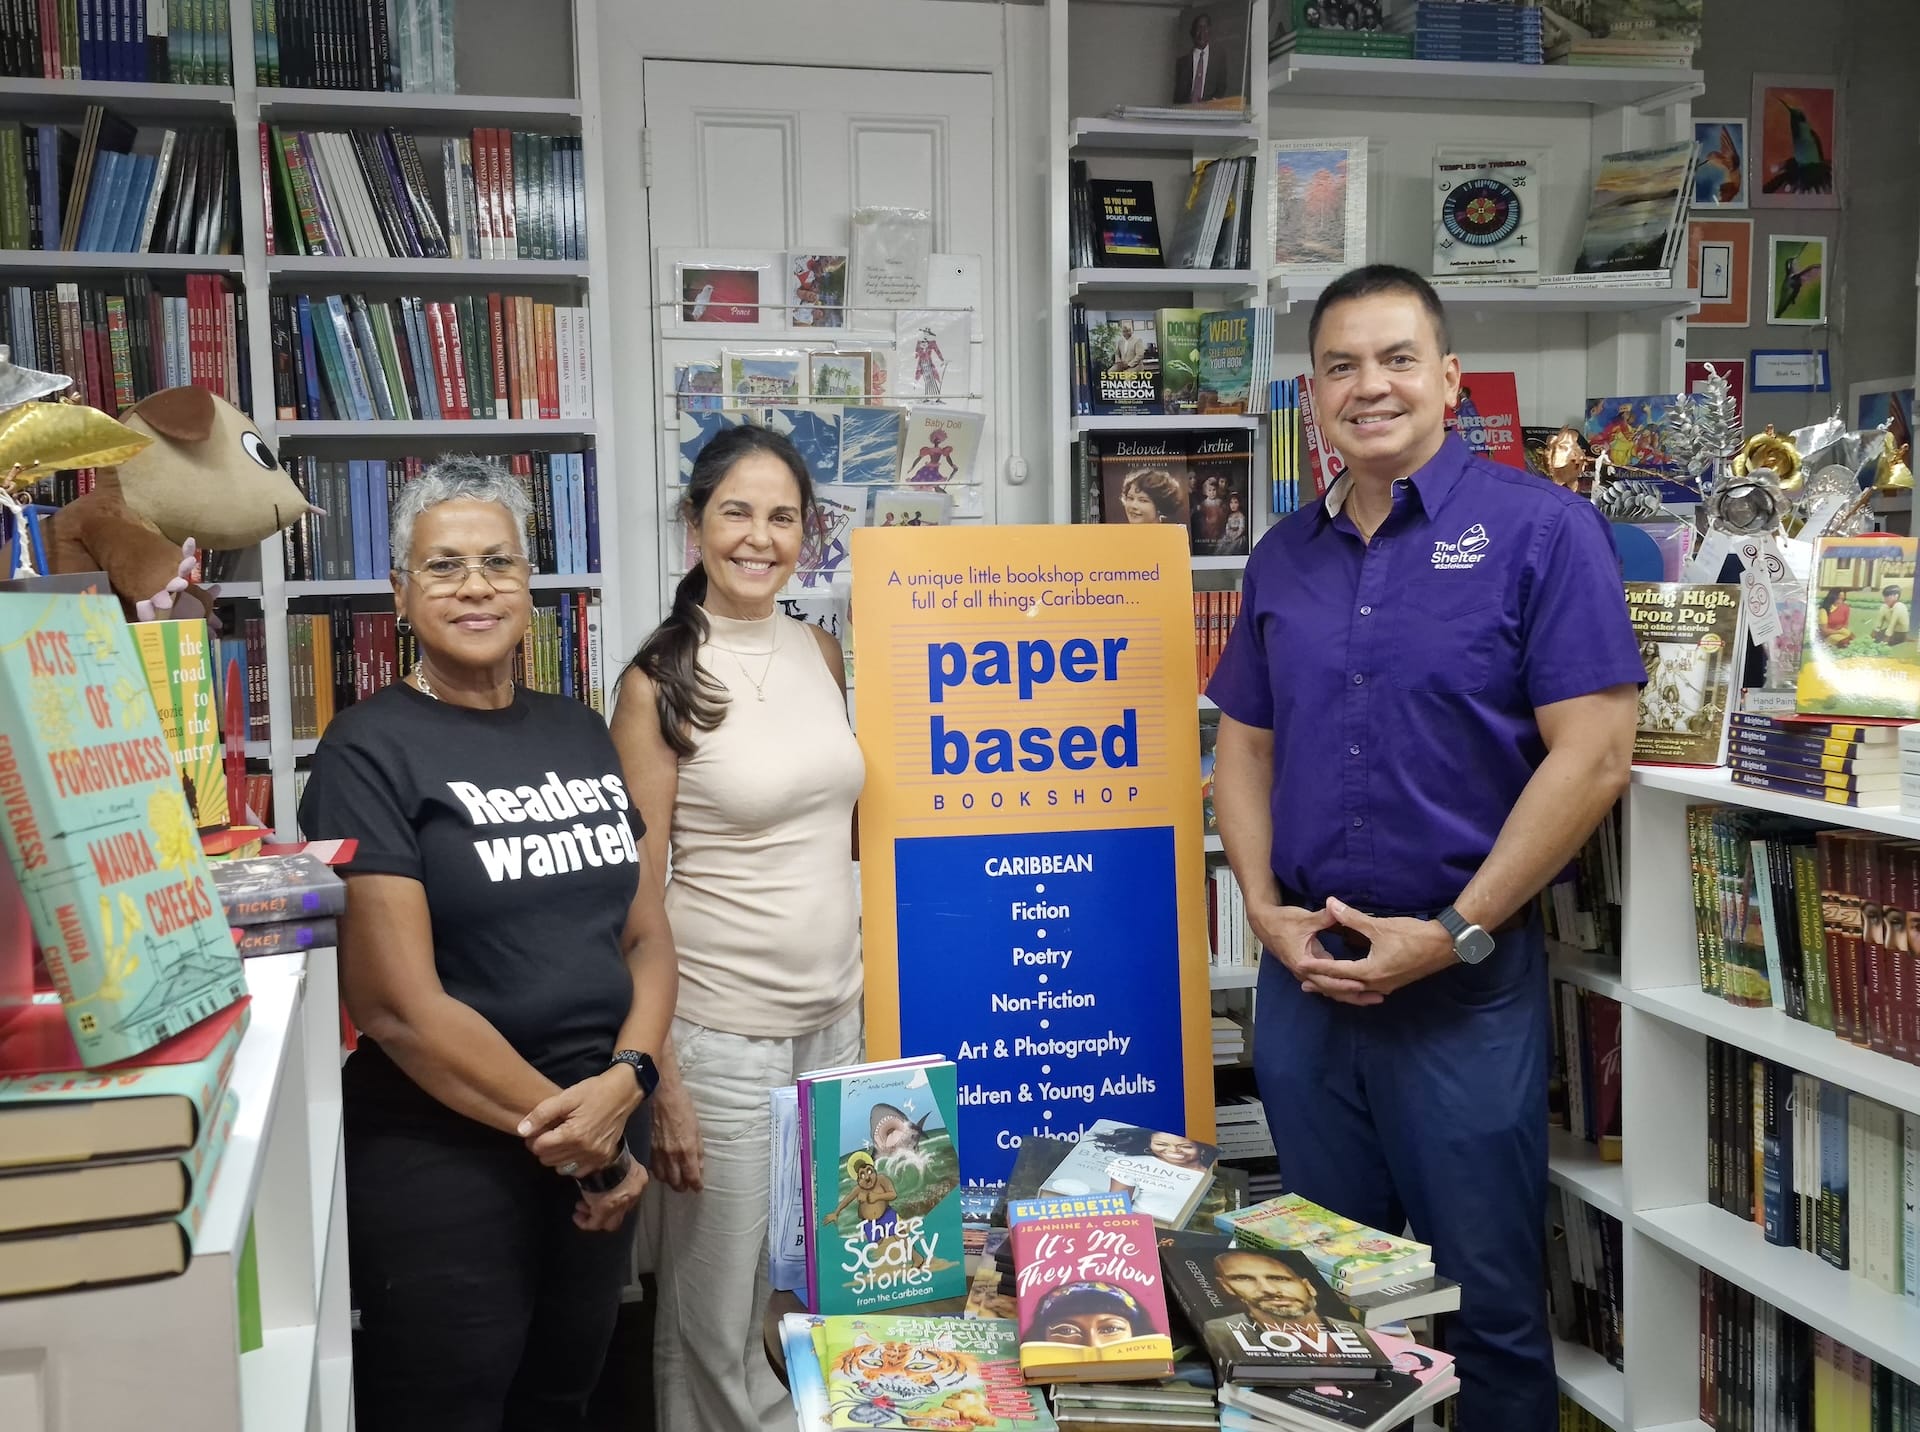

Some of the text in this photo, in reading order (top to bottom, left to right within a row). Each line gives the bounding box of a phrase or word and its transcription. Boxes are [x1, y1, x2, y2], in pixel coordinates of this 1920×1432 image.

[1488, 160, 1527, 168] TRINIDAD
[49, 304, 59, 341] SHAPING
[731, 306, 751, 316] Peace
[560, 316, 568, 332] INDIA
[578, 316, 586, 333] INDIA
[1209, 318, 1248, 343] WRITE
[494, 312, 505, 393] BEYOND BOUNDARIES
[1210, 357, 1242, 368] YOUR BOOK
[439, 347, 454, 407] Williams SPEAKS
[453, 347, 468, 407] Williams SPEAKS
[1102, 390, 1154, 398] FREEDOM
[925, 418, 962, 428] Baby Doll
[1299, 391, 1317, 451] KING SOCA
[1117, 441, 1166, 455] Beloved
[1197, 438, 1234, 453] Archie
[1470, 429, 1514, 444] OVER
[1431, 552, 1486, 564] Shelter
[1434, 541, 1456, 552] The
[888, 563, 1160, 589] A unique little bookshop crammed
[912, 589, 1140, 612] full of all things Caribbean...
[1682, 586, 1736, 609] High,
[1630, 607, 1716, 624] Iron Pot
[25, 630, 77, 678] ACTS
[179, 633, 203, 657] the
[525, 633, 534, 660] Beyond
[173, 658, 206, 684] road
[928, 636, 1129, 703] paper
[84, 684, 113, 729] OF
[194, 692, 208, 707] to
[188, 714, 210, 736] the
[175, 743, 214, 765] untry
[930, 709, 1138, 776] based
[48, 736, 172, 798] FORGIVENESS
[446, 771, 629, 825] Readers
[934, 786, 1138, 810] BOOKSHOP
[87, 829, 157, 888] MAURA
[985, 854, 1093, 877] CARIBBEAN
[144, 875, 214, 937] CHEEKS
[238, 897, 288, 914] TICKET
[1012, 901, 1069, 921] Fiction
[1795, 857, 1811, 946] ANGEL IN TOBAGO
[1807, 859, 1823, 949] ANGEL IN TOBAGO
[55, 903, 90, 964] MAURA
[1697, 933, 1705, 958] Helen
[1013, 948, 1072, 968] Poetry
[1708, 934, 1716, 959] Helen
[1718, 938, 1727, 963] Helen
[1870, 945, 1879, 993] PHILIPPINE
[1894, 953, 1902, 1001] PHILIPPINE
[991, 990, 1095, 1012] Non-Fiction
[957, 1031, 1131, 1060] Art & Photography
[957, 1074, 1156, 1105] ildren & Young Adults
[1754, 1109, 1764, 1153] RUSH
[1078, 1149, 1192, 1181] BECOMING
[1017, 1198, 1125, 1216] ELIZABETH
[856, 1216, 926, 1243] Three
[1021, 1219, 1140, 1233] JEANNINE A. COOK
[841, 1232, 939, 1273] Scary
[1035, 1229, 1141, 1260] It's Me
[851, 1263, 933, 1295] Stories
[1018, 1253, 1155, 1297] They Follow
[1185, 1260, 1211, 1288] HADEED
[857, 1286, 933, 1307] from the Caribbean
[1203, 1289, 1224, 1308] TROY
[1226, 1321, 1353, 1333] MY NAME IS
[1126, 1344, 1157, 1352] NOVEL
[1232, 1331, 1370, 1354] LOVE
